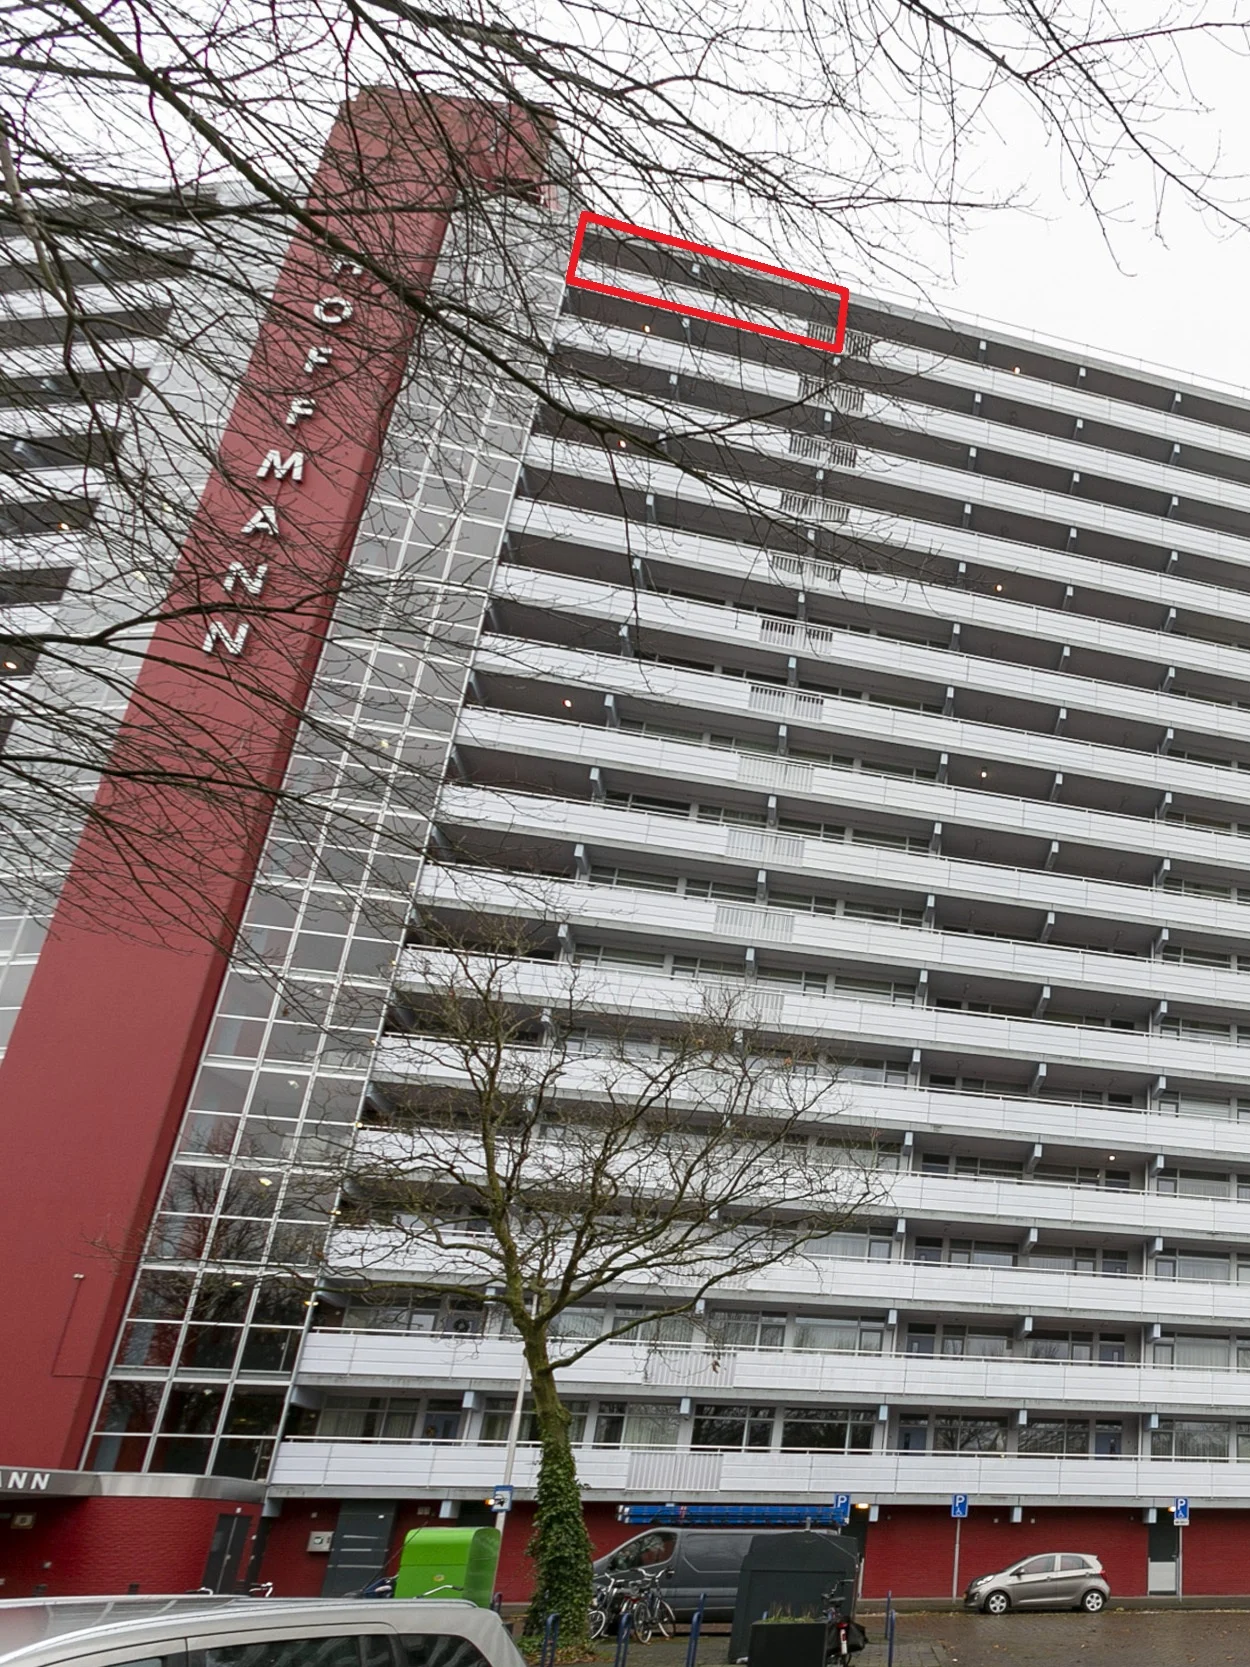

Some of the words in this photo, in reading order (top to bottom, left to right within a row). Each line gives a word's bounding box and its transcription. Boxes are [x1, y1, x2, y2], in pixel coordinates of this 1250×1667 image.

[0, 1471, 50, 1490] NN
[838, 1496, 847, 1508] P
[956, 1496, 965, 1507] P
[1177, 1498, 1186, 1510] P
